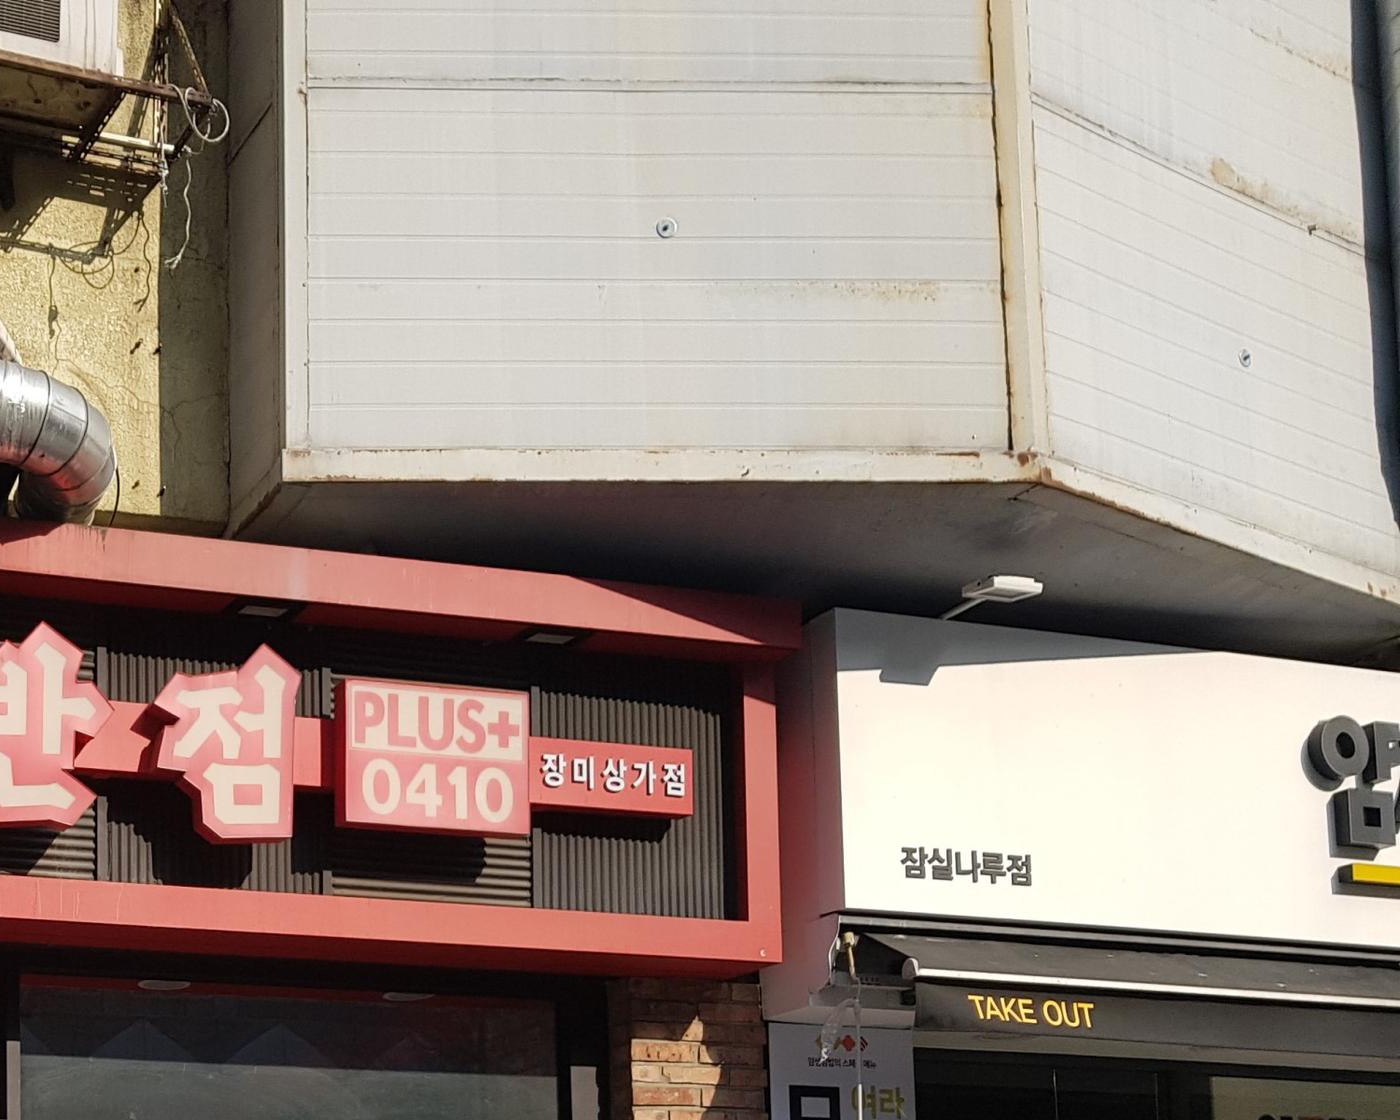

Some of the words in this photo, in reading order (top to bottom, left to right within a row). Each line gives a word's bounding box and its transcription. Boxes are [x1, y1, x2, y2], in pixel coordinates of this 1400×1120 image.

[361, 758, 514, 823] 0410
[541, 752, 688, 800] 장미상가점
[899, 845, 1033, 887] 잠실나루점
[968, 994, 1036, 1025] TAKE
[1043, 999, 1095, 1029] OUT
